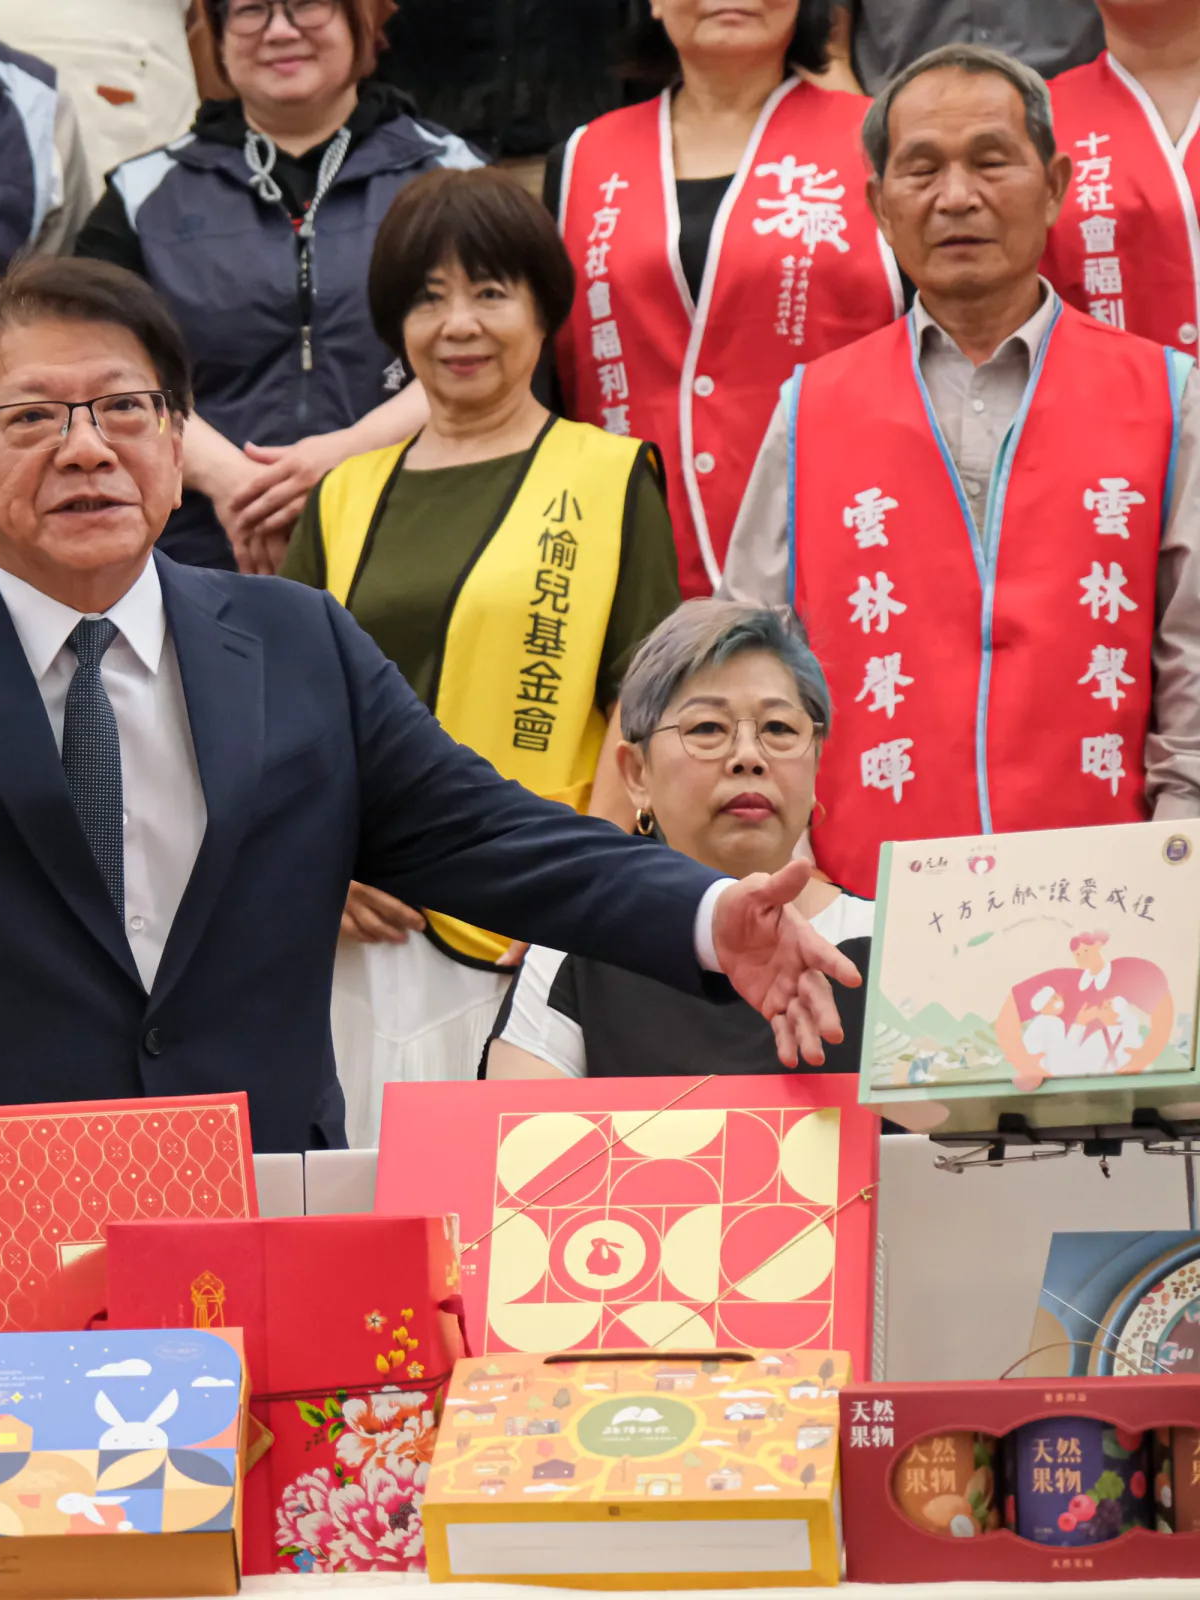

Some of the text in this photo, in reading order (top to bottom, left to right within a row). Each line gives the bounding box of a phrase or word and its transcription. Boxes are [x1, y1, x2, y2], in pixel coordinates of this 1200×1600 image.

[1075, 131, 1126, 331] 十方社會福利
[512, 489, 584, 753] 小愉兒基金會
[843, 487, 916, 804] 雲林聲暉
[1076, 477, 1146, 797] 雲林聲暉
[849, 1399, 895, 1423] 天然
[849, 1425, 895, 1448] 果物
[1031, 1437, 1083, 1464] 天然
[904, 1467, 956, 1494] 果物
[1031, 1466, 1083, 1494] 果物
